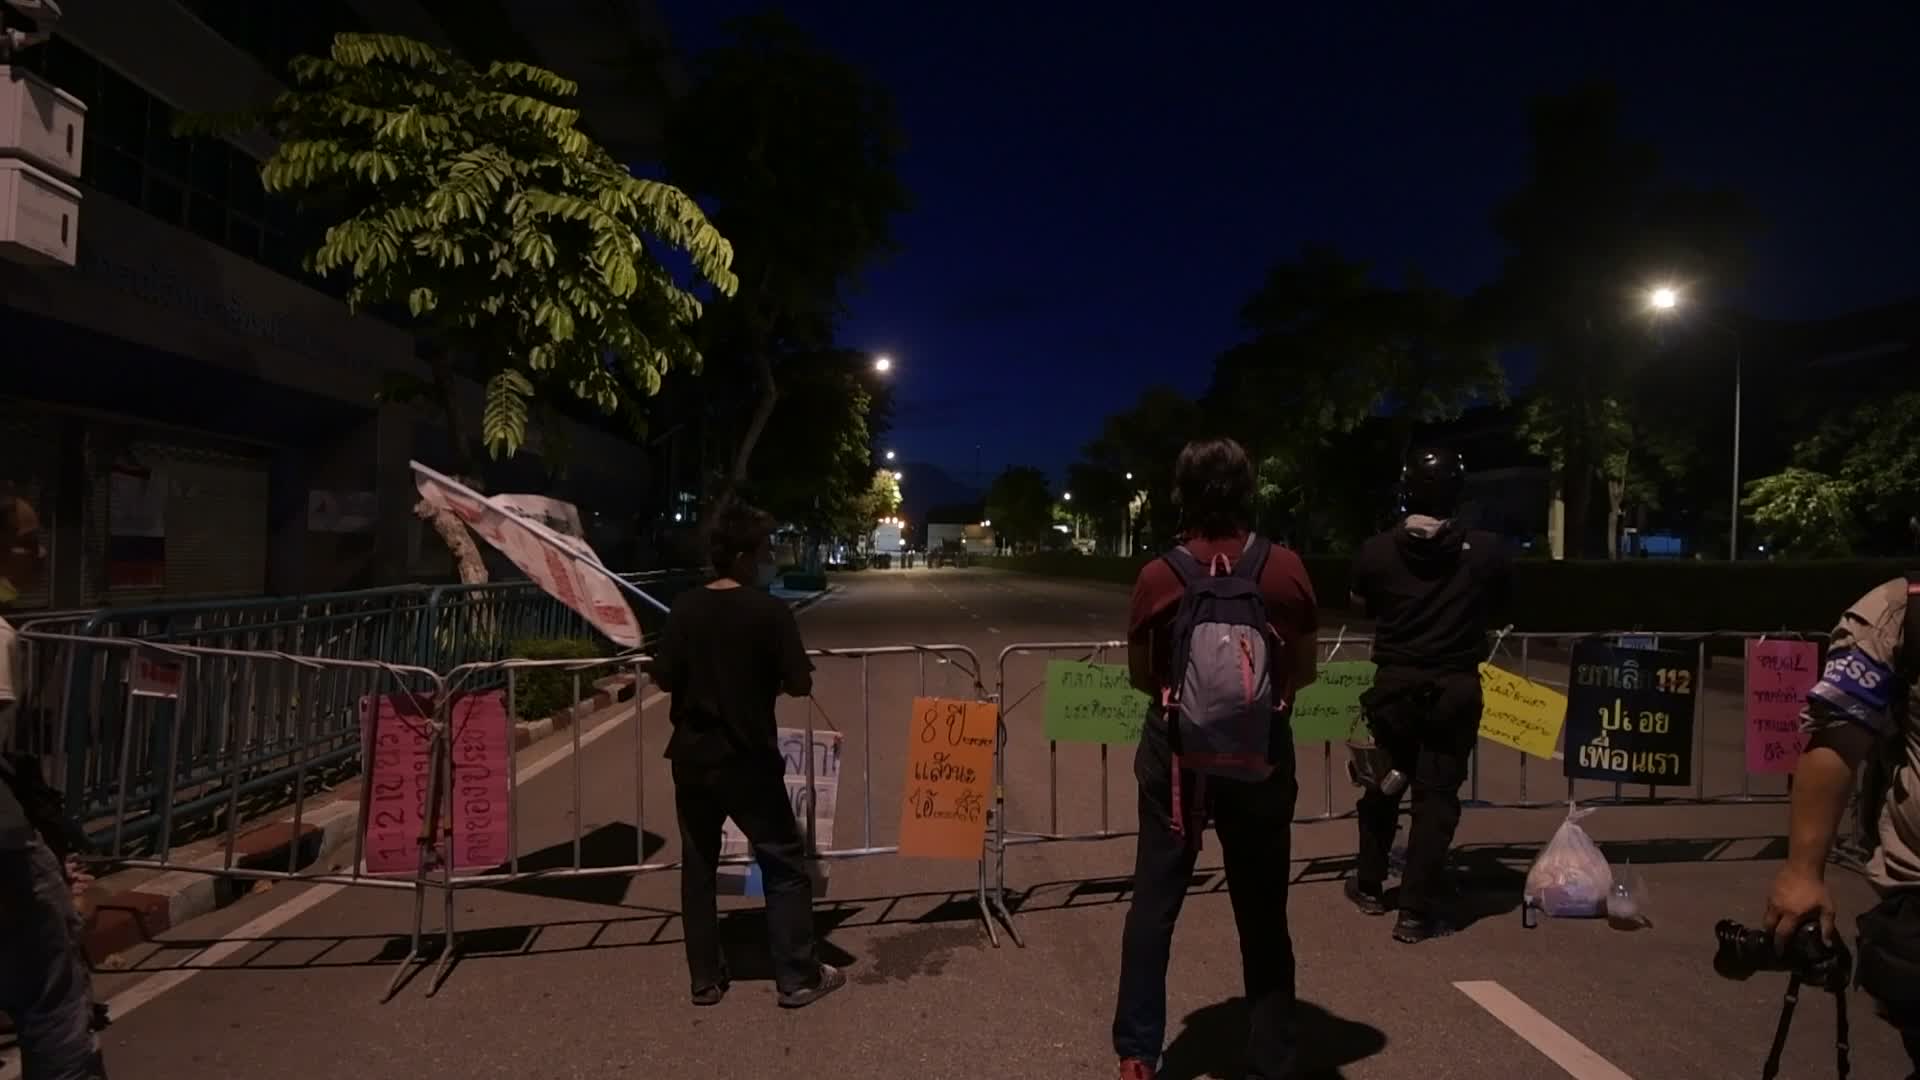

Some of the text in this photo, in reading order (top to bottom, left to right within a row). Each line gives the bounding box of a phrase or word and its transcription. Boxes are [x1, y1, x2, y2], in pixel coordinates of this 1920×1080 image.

[1655, 667, 1692, 694] 112
[920, 702, 940, 744] 8
[914, 751, 977, 784] แล้วนะ
[1578, 729, 1680, 776] เพื่อนเรา
